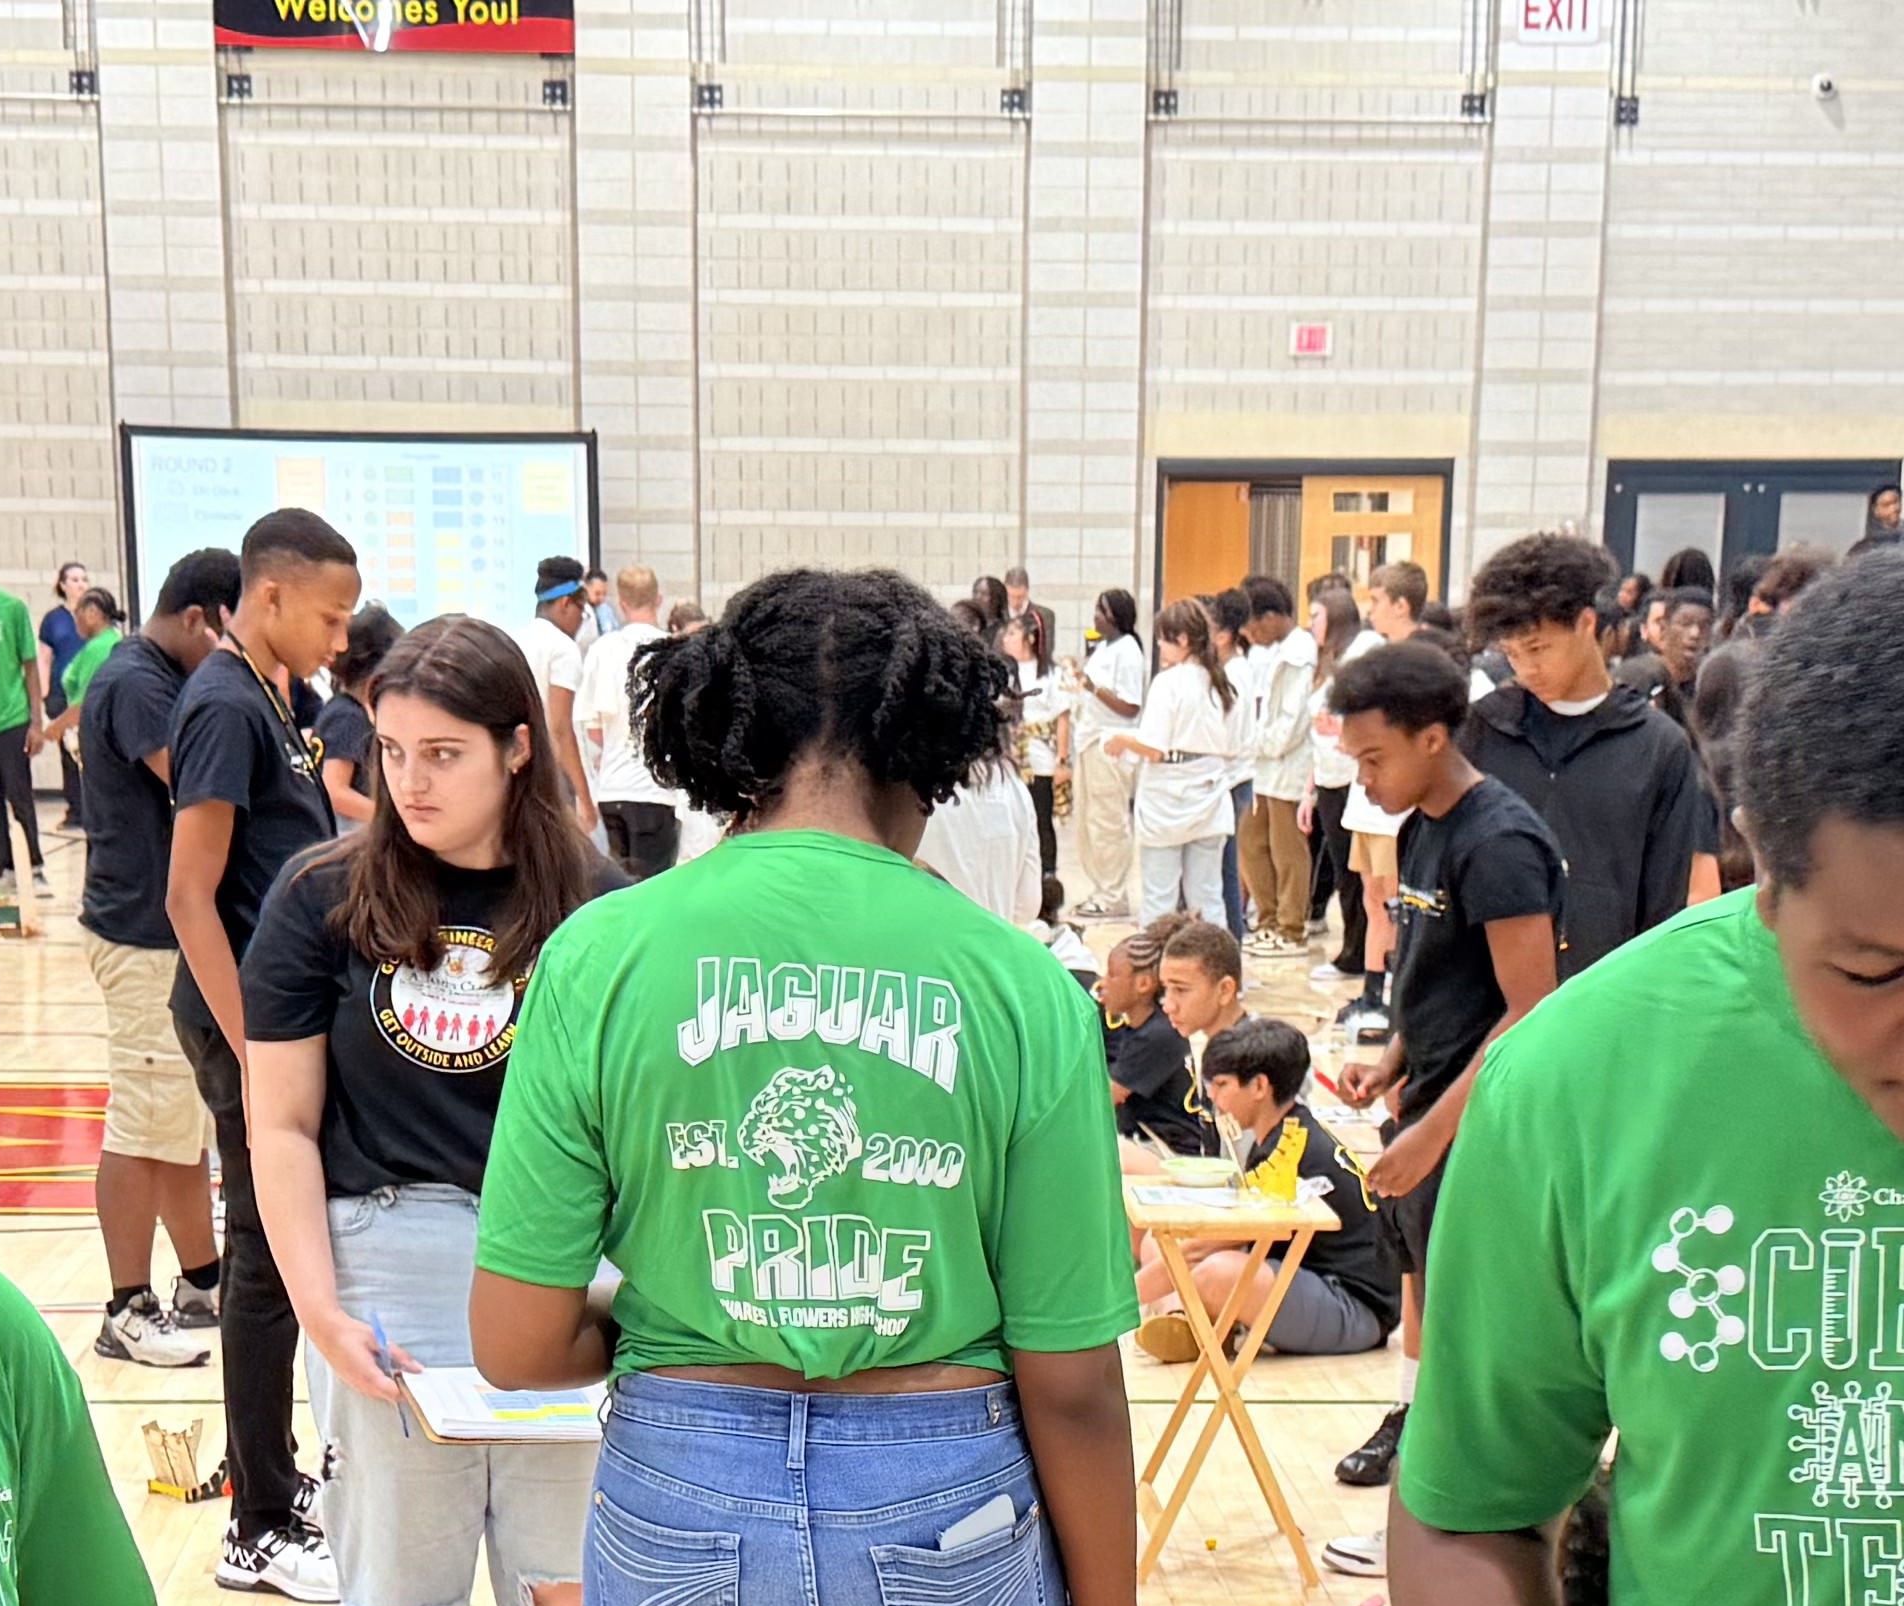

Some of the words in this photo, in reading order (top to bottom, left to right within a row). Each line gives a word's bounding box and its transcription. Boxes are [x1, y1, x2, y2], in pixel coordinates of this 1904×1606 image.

[277, 0, 438, 24] Welcoes
[455, 0, 519, 26] You!
[1524, 0, 1588, 31] EXIT
[151, 457, 218, 473] ROUND
[380, 1009, 401, 1033] GET
[396, 1033, 450, 1067] OUTSIDE
[454, 1052, 483, 1068] AND
[677, 956, 962, 1095] JAGUAR
[666, 1120, 739, 1170] EST.
[862, 1133, 966, 1189] 2000
[702, 1209, 931, 1311] PRIDE
[779, 1306, 848, 1328] FLOWERS
